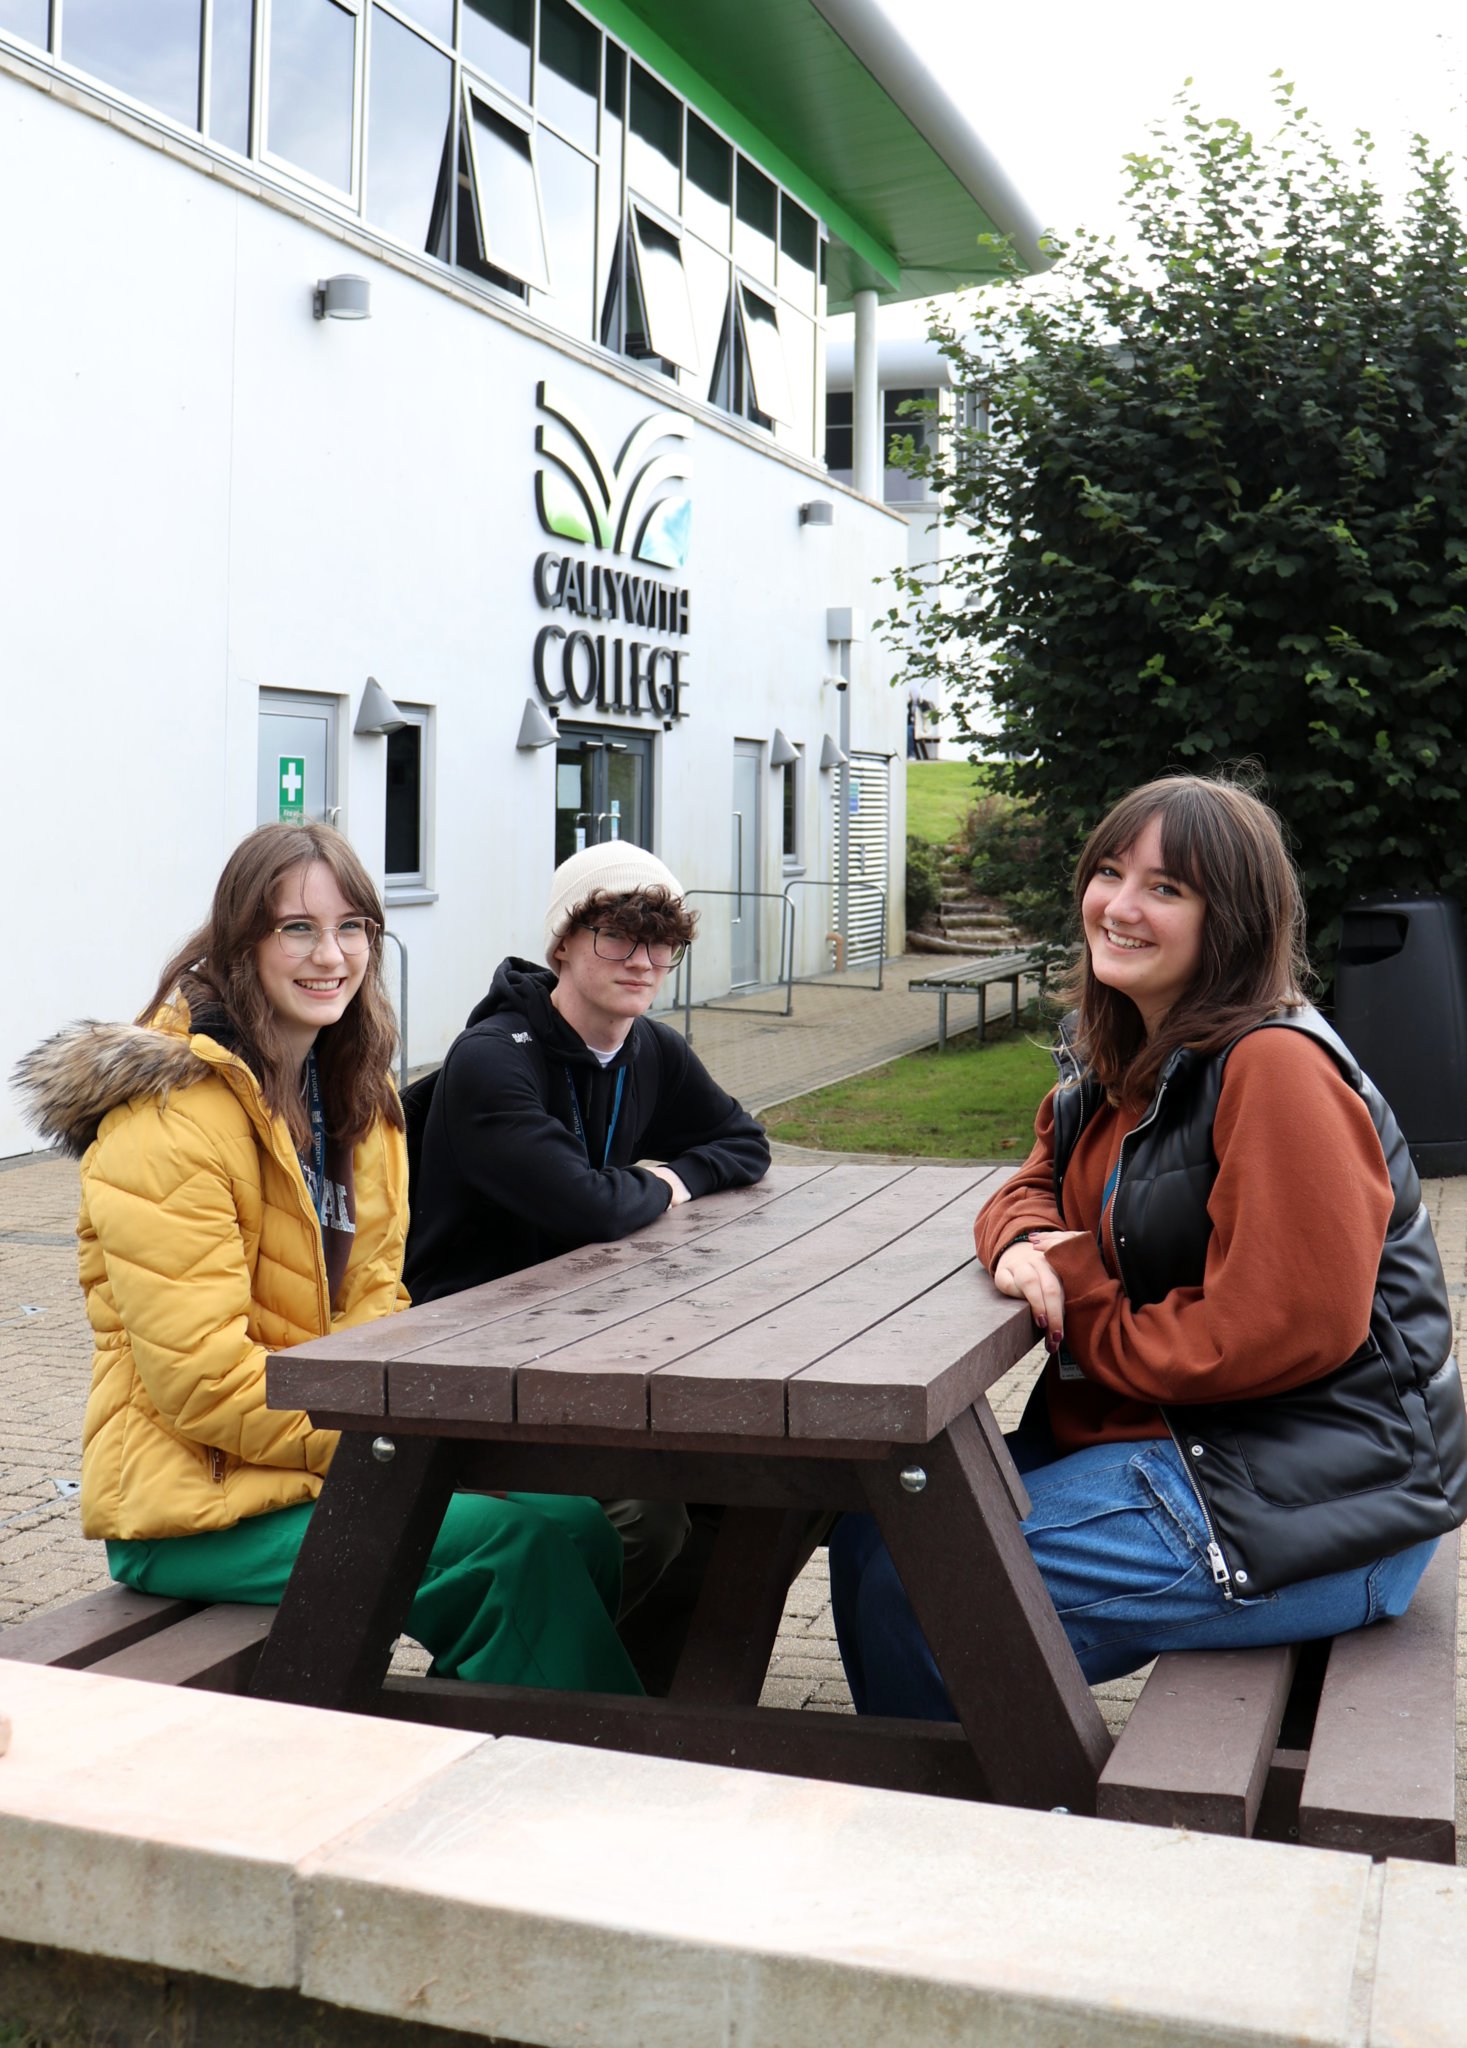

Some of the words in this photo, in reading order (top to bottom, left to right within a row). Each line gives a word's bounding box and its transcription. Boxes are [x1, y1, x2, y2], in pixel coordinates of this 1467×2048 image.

[534, 551, 689, 635] CALLYWITH
[533, 624, 690, 720] COLLEGE
[311, 1068, 319, 1102] STUDENT
[314, 1131, 322, 1166] STUDENT
